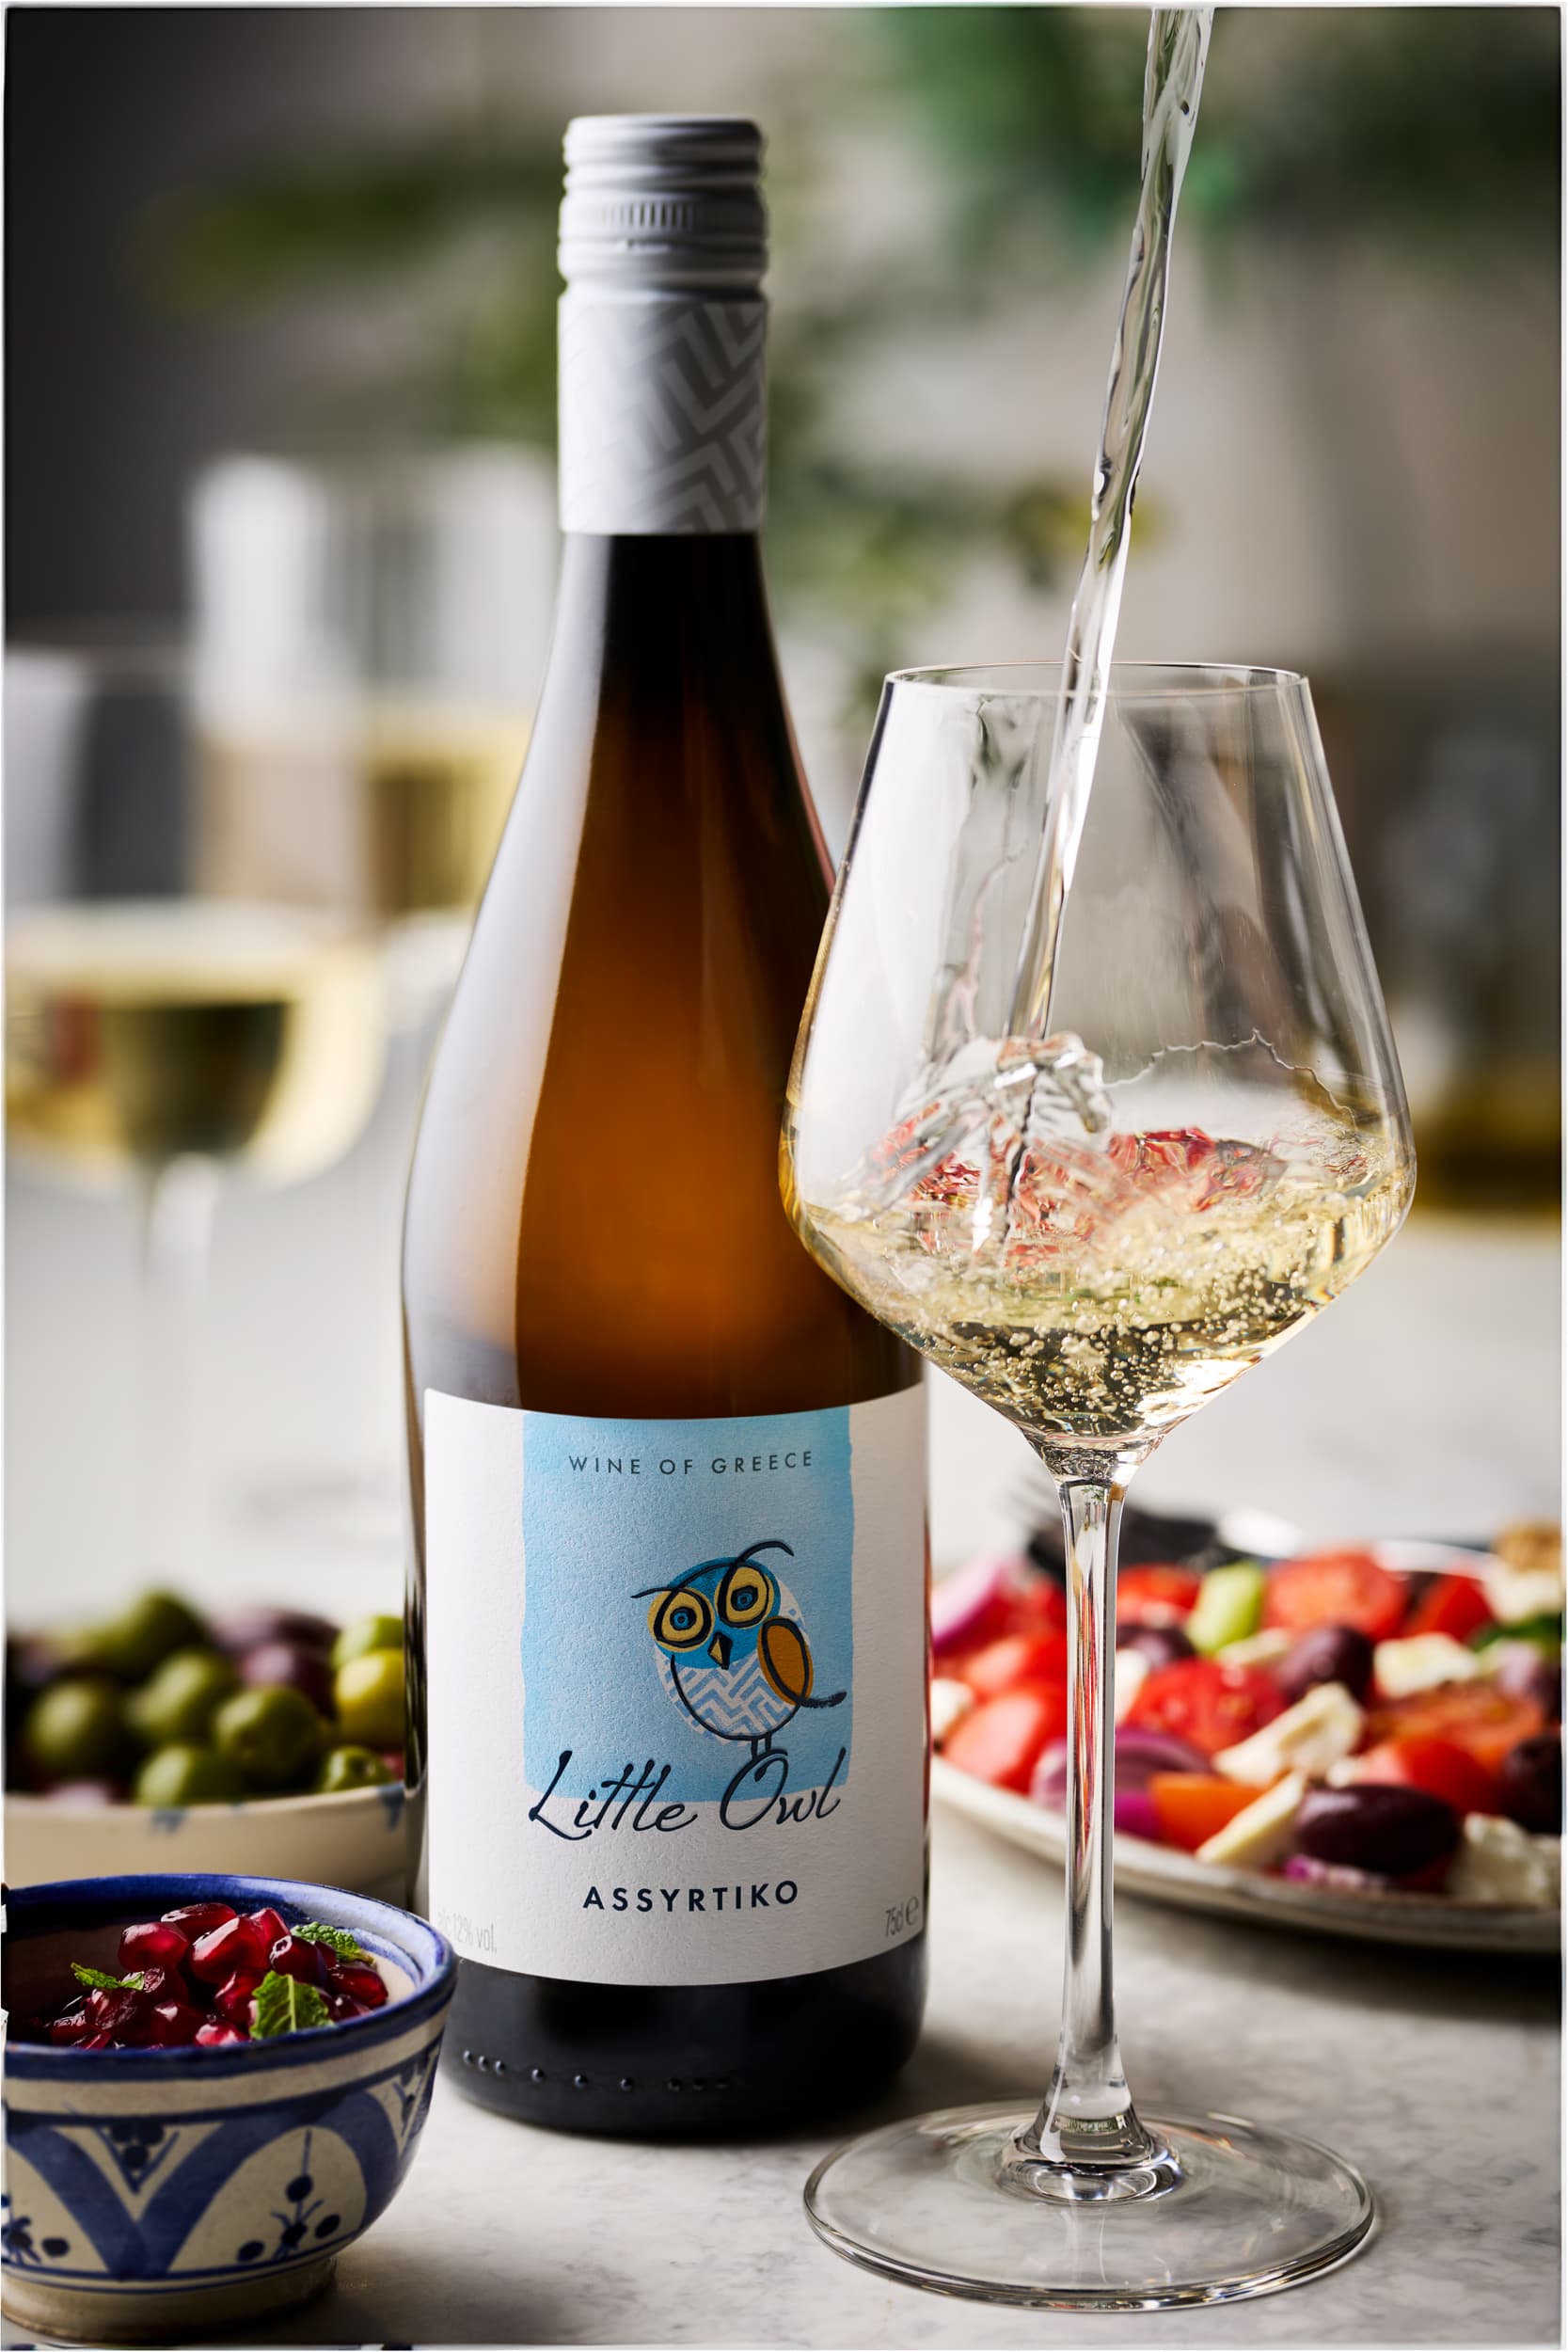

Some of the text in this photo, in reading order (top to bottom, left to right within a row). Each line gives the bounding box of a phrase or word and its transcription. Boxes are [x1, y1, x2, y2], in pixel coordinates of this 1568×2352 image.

[568, 1451, 812, 1475] WINE OF GREECE
[529, 1748, 847, 1841] Little Owl
[582, 1881, 798, 1912] ASSYRTIKO
[476, 1923, 498, 1953] vol.
